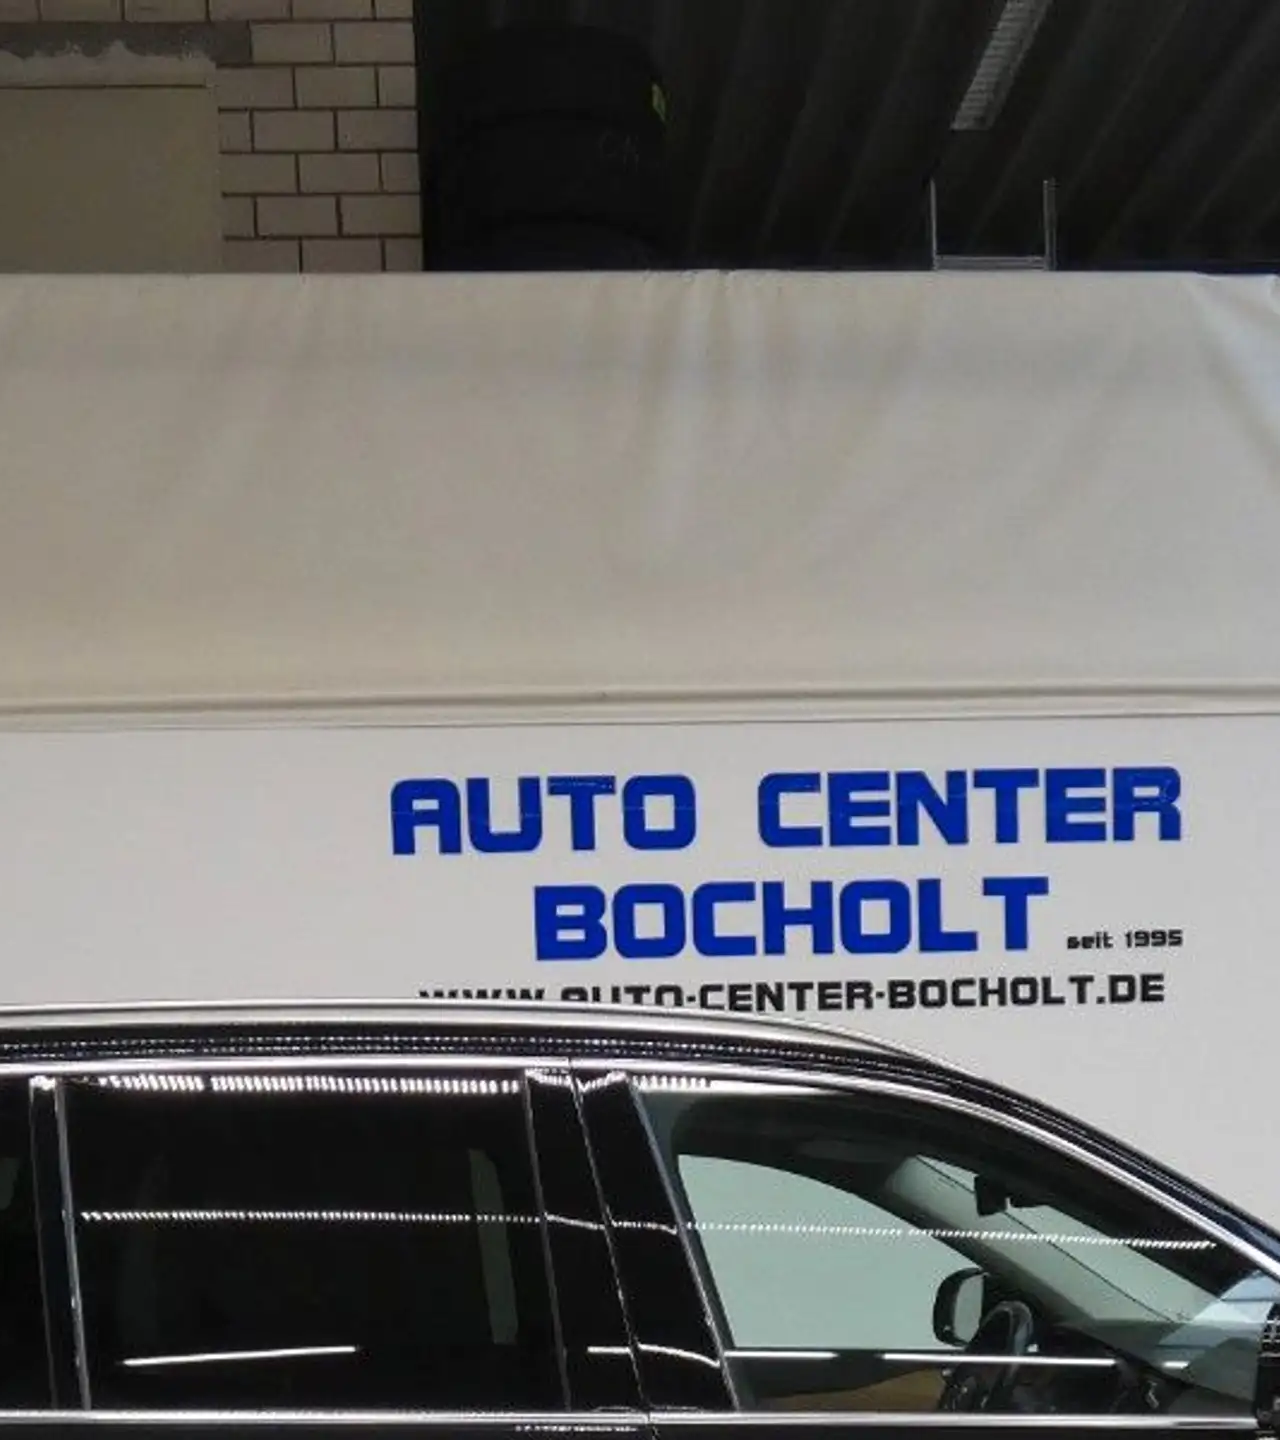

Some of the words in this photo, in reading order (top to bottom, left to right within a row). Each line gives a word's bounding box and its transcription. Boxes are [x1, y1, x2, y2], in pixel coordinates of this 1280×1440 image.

[391, 775, 696, 855] AUTO
[758, 768, 1181, 847] CENTER
[534, 877, 1049, 961] BOCHOLT
[1066, 930, 1113, 951] seit
[1124, 929, 1183, 949] 1995
